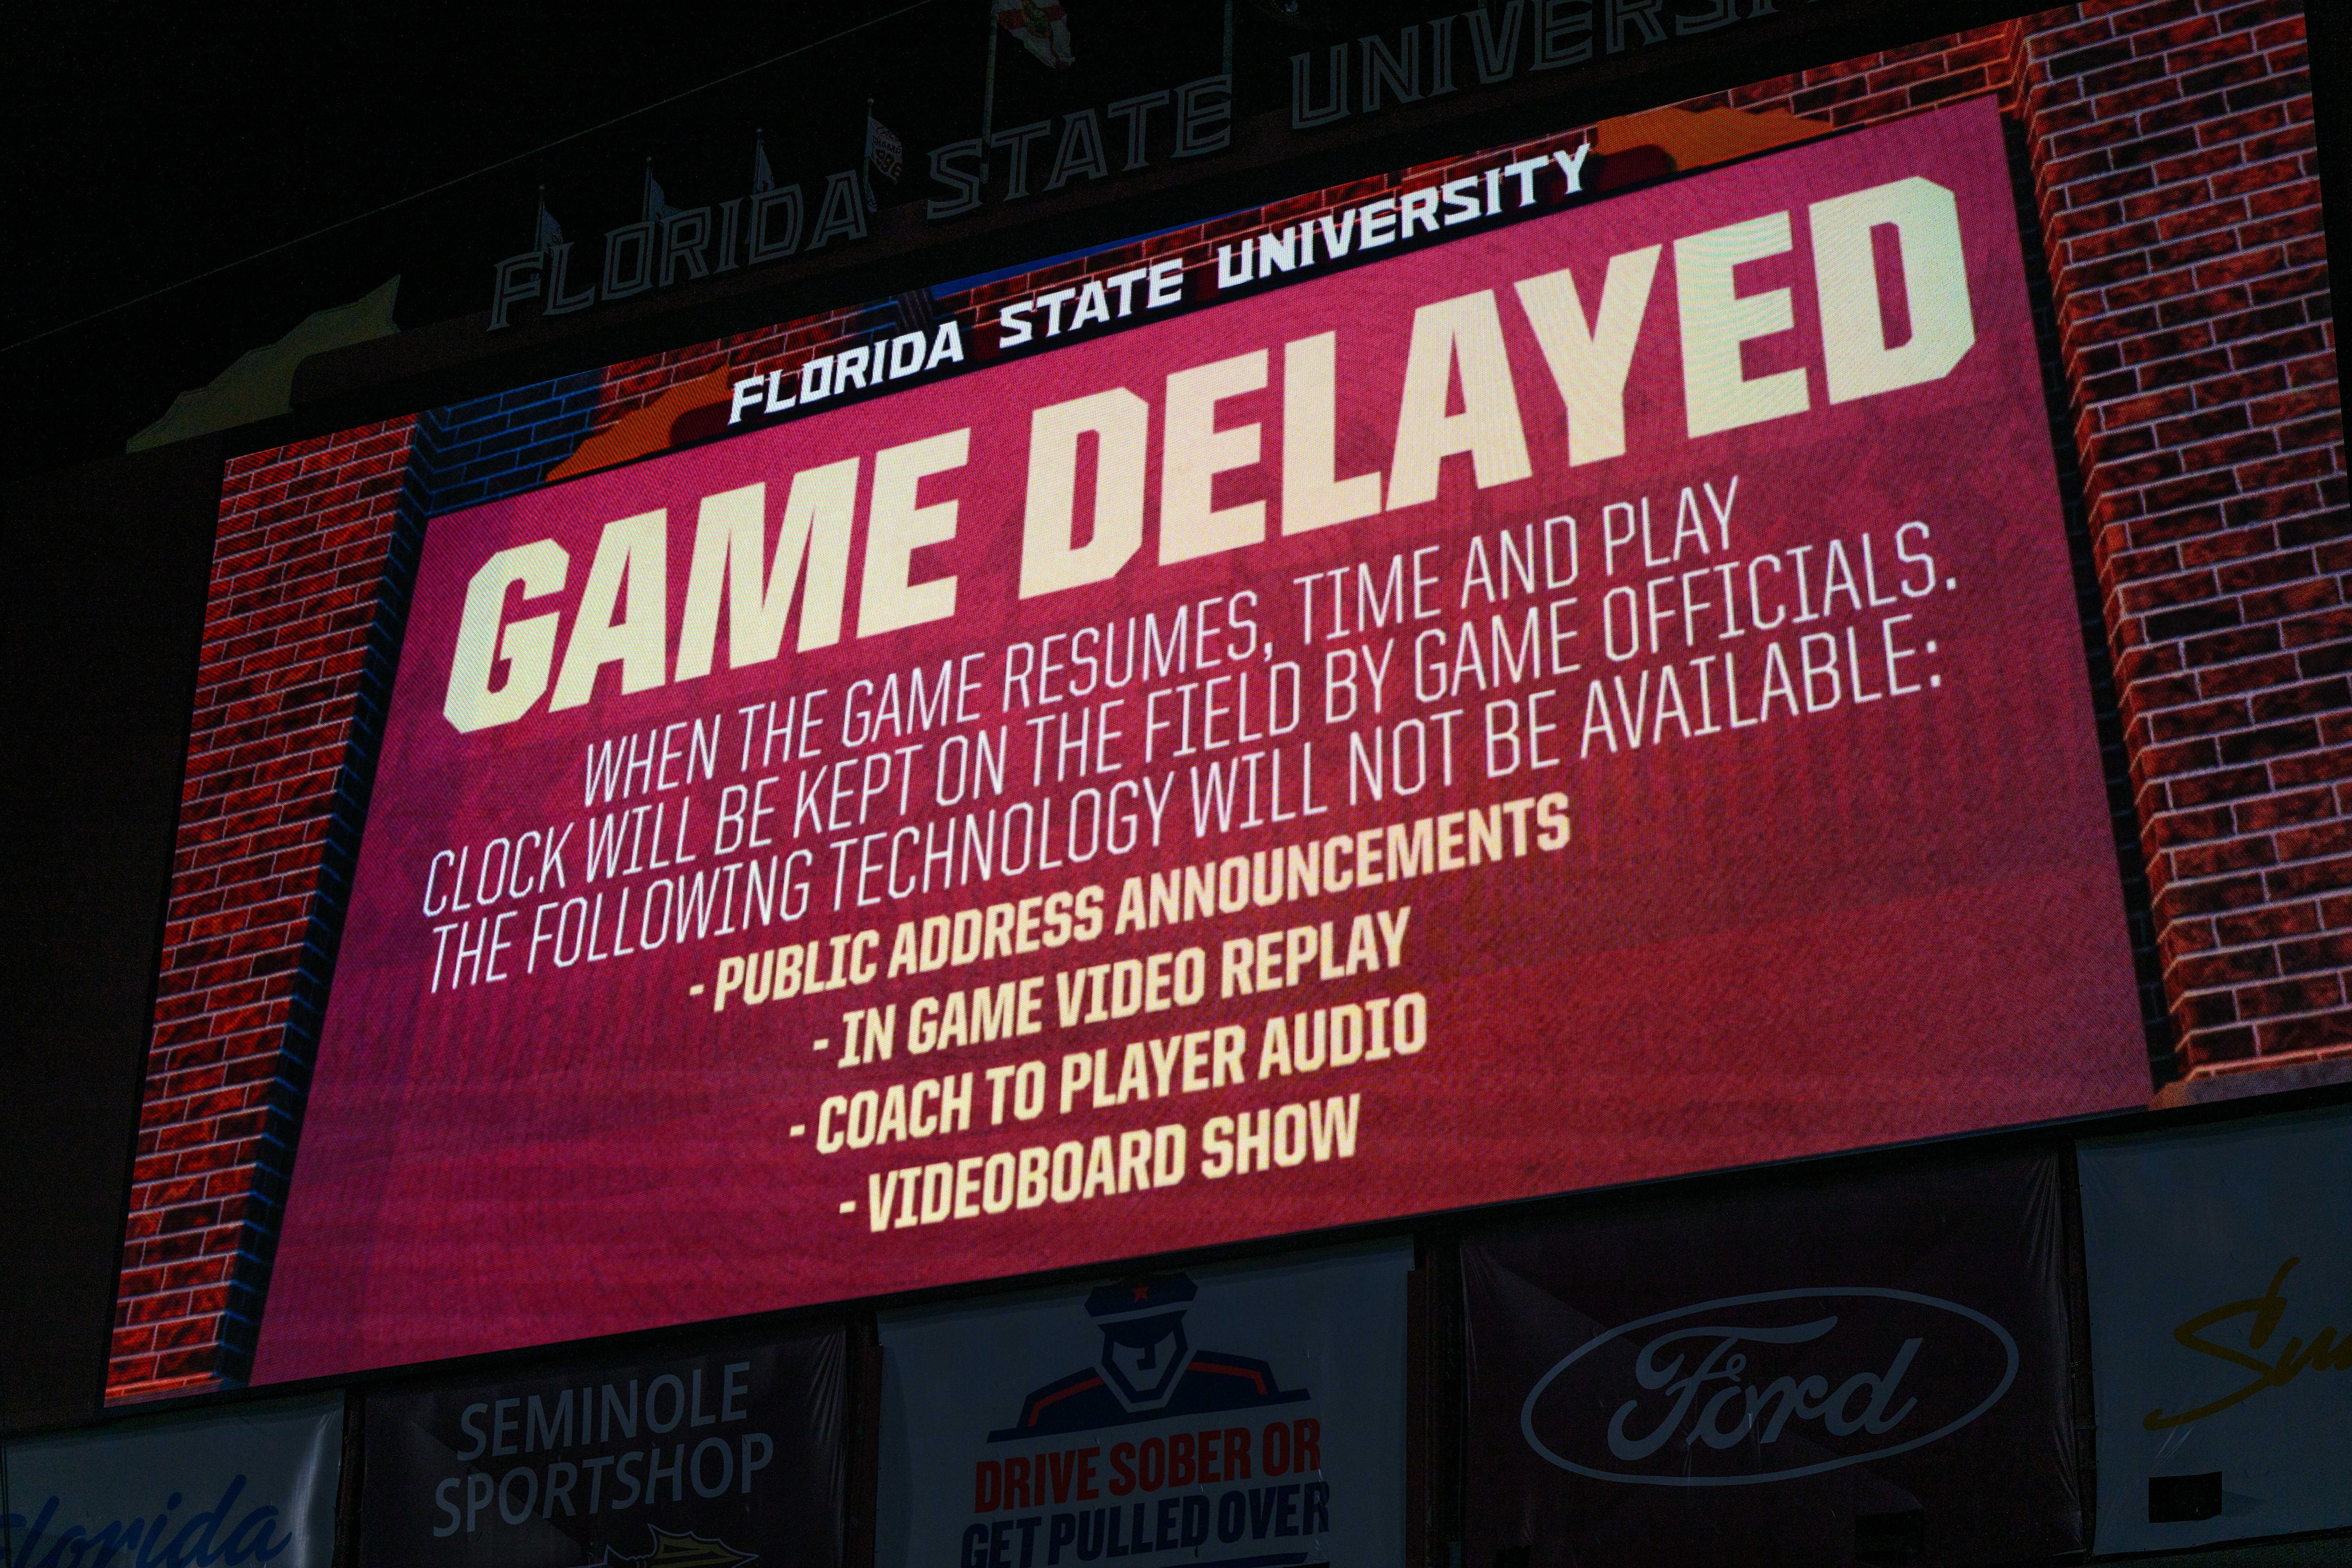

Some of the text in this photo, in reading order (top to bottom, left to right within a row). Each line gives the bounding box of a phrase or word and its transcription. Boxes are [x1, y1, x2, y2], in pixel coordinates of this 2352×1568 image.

[486, 0, 1820, 332] FLORIDA STATE UNIVER
[729, 142, 1590, 424] FLORIDA STATE UNIVERSITY
[443, 175, 1976, 734] GAME DELAYED
[422, 520, 1957, 917] CLOCK WILL BE KEPT ON THE FIELD BY GAME OFFICIALS.
[584, 476, 1739, 807] WHEN THE GAME RESUMES, TIME AND PLAY
[431, 613, 1941, 993] THE FOLLOWING TECHNOLOGY WILL NOT BE AVAILABLE:
[713, 929, 881, 1012] PUBLIC
[887, 884, 1105, 979] ADDRESS
[1114, 791, 1571, 936] ANNOUNCEMENTS
[837, 1003, 897, 1069] IN
[906, 976, 1045, 1055] GAME
[1056, 946, 1207, 1028] VIDEO
[1220, 906, 1411, 999] REPLAY
[816, 1071, 974, 1155] COACH
[985, 1059, 1047, 1126] TO
[1059, 1024, 1247, 1114] PLAYER
[1257, 991, 1428, 1080] AUDIO
[868, 1123, 1188, 1233] VIDEOBOARD
[1200, 1092, 1361, 1179] SHOW
[457, 1361, 751, 1462] SEMINOLE
[975, 1417, 1321, 1514] DRIVE SOBER OR
[1607, 1315, 1924, 1461] Ford
[0, 1474, 292, 1568] lorida
[433, 1433, 774, 1537] SPORTSHOP
[961, 1481, 1331, 1568] GET PULLED OVER
